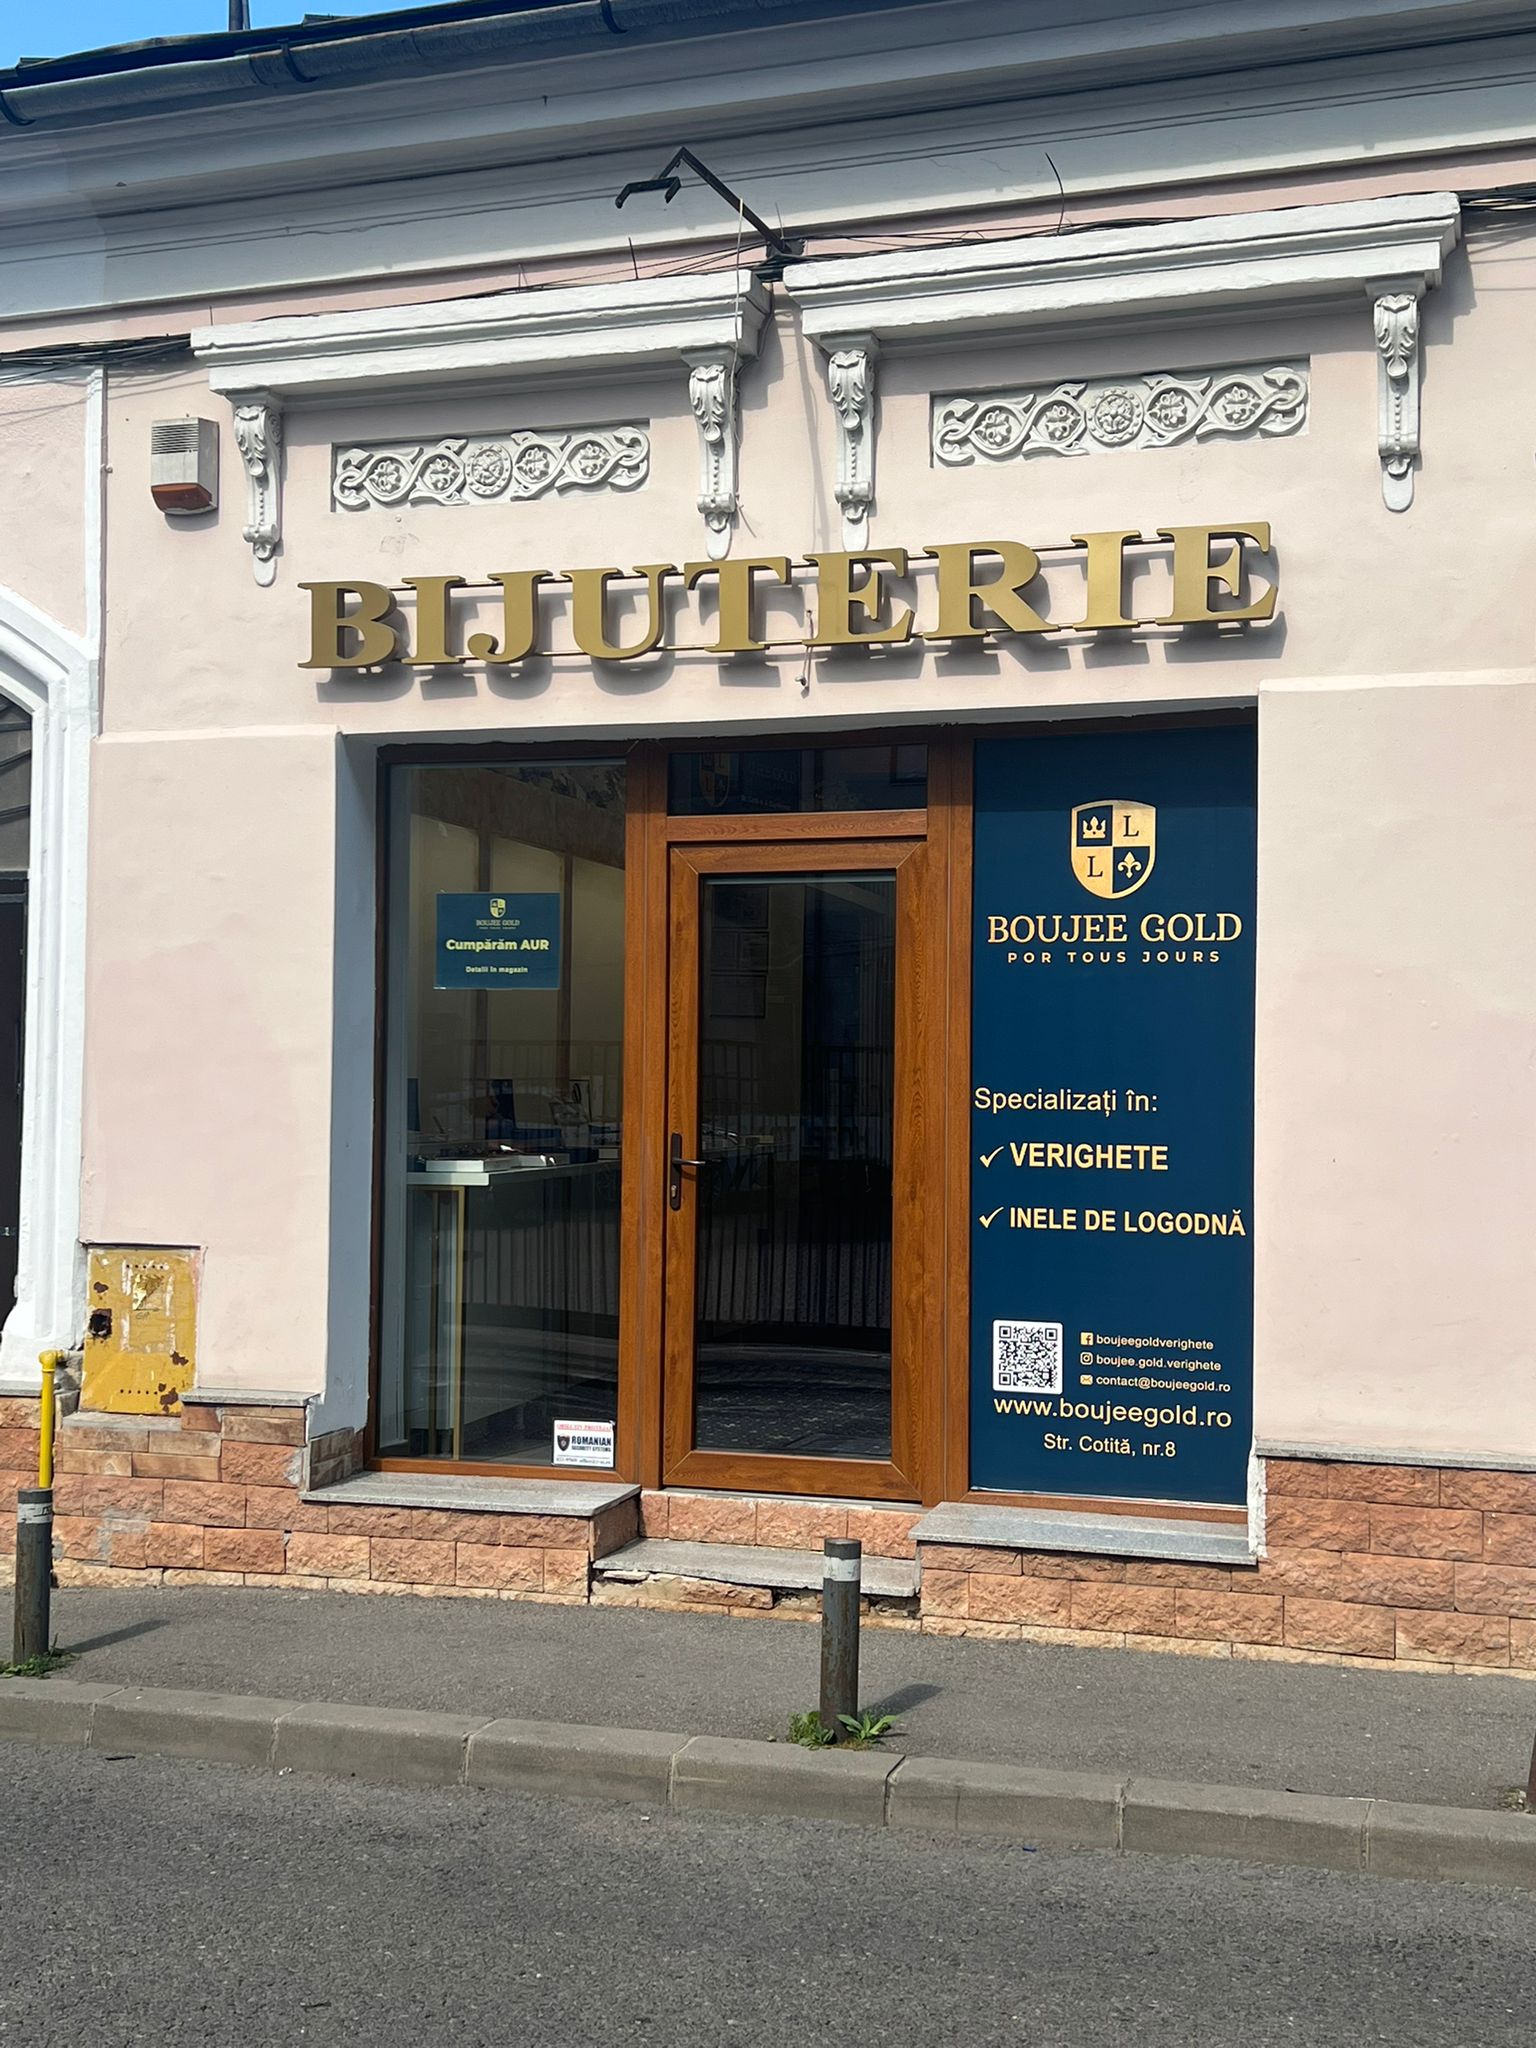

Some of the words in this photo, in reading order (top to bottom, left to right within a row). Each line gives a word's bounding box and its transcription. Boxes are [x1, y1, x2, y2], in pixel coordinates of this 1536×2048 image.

[298, 522, 1276, 669] BIJUTERIE
[1123, 815, 1139, 837] L
[1087, 856, 1103, 877] L
[987, 914, 1128, 943] BOUJEE
[1139, 913, 1243, 942] GOLD
[446, 939, 517, 952] Cumpărăm
[520, 939, 549, 950] AUR
[1007, 952, 1052, 963] POR
[1067, 951, 1127, 963] TOUS
[1142, 951, 1220, 963] JOURS
[974, 1087, 1117, 1117] Specializați
[1125, 1089, 1159, 1112] în:
[1009, 1142, 1169, 1170] VERIGHETE
[1009, 1207, 1077, 1230] INELE
[1084, 1209, 1116, 1231] DE
[1124, 1208, 1246, 1236] LOGODNĂ
[1096, 1334, 1214, 1350] boujeegoldverighete
[1096, 1354, 1222, 1372] boujee.gold.verighete
[1096, 1375, 1231, 1392] contact@boujeegold.ro
[993, 1398, 1232, 1428] www.boujeegold.ro
[571, 1435, 612, 1446] ROMANIAN
[1043, 1433, 1073, 1450] Str.
[1079, 1436, 1136, 1456] Cotită,
[1142, 1442, 1176, 1457] nr.8
